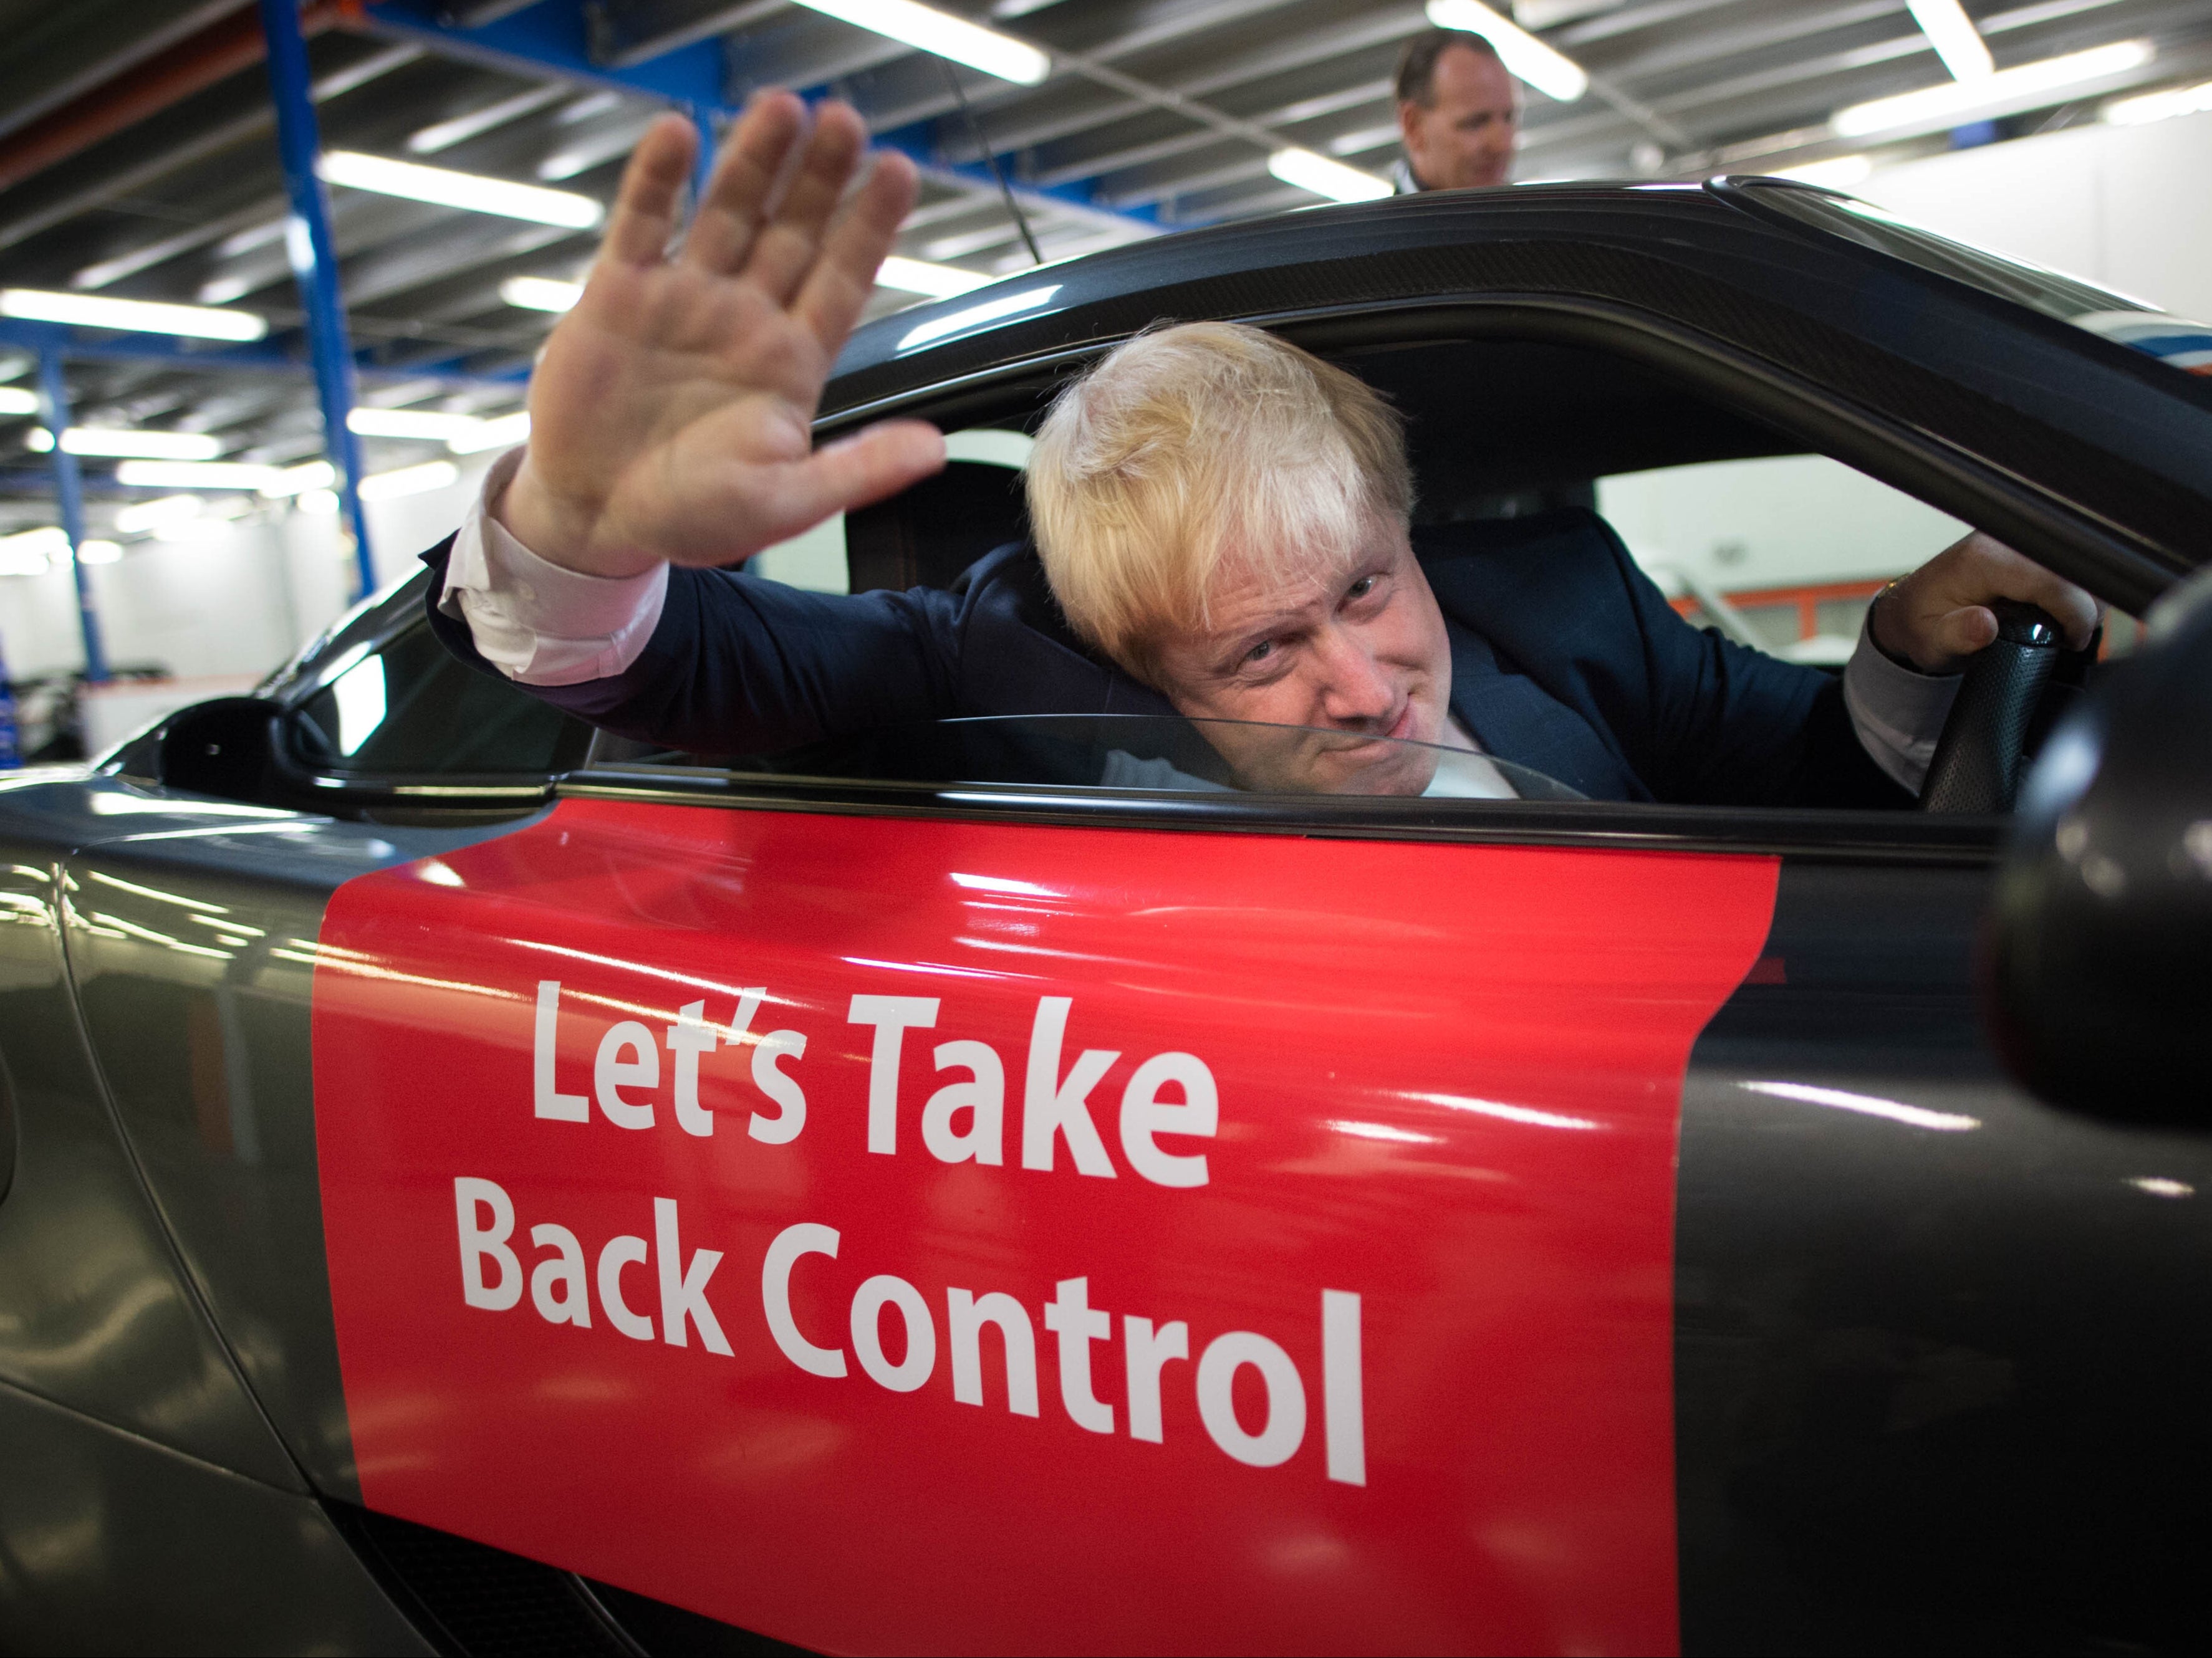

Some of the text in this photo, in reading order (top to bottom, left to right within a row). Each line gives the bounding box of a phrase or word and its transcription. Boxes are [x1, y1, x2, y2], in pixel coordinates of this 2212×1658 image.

[532, 980, 1219, 1188] Let's Take
[454, 1177, 1366, 1487] Back Control
